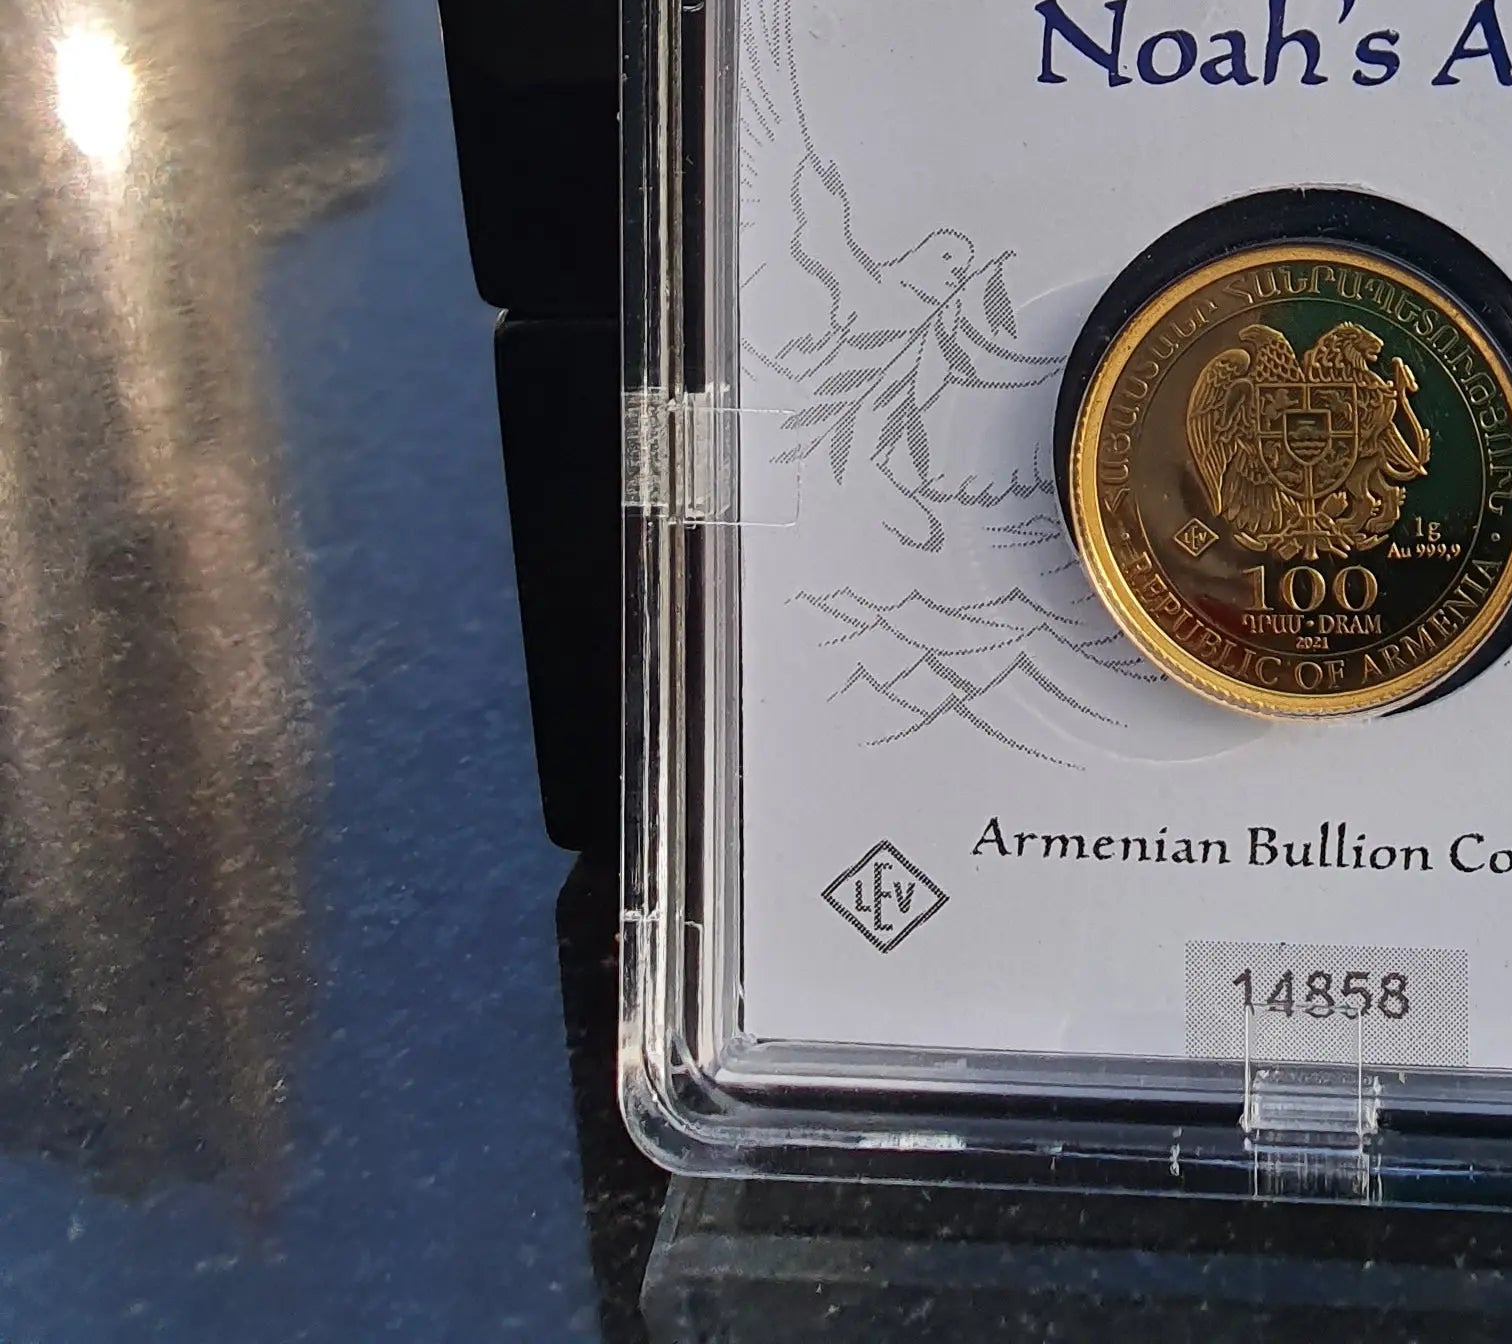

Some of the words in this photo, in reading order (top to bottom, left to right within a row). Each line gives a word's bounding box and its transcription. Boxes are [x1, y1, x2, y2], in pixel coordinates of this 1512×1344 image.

[1415, 516, 1441, 542] 1g
[1387, 542, 1412, 560] Au
[1241, 565, 1378, 612] 100
[1121, 552, 1282, 686] REPUBLIC
[1294, 659, 1345, 690] OF
[1362, 559, 1502, 684] ARMENIA
[1319, 614, 1382, 634] DRAM
[1296, 637, 1330, 650] 2021
[973, 818, 1231, 868] Armenian
[1248, 822, 1433, 873] Bullion
[1232, 968, 1410, 1020] 14858
